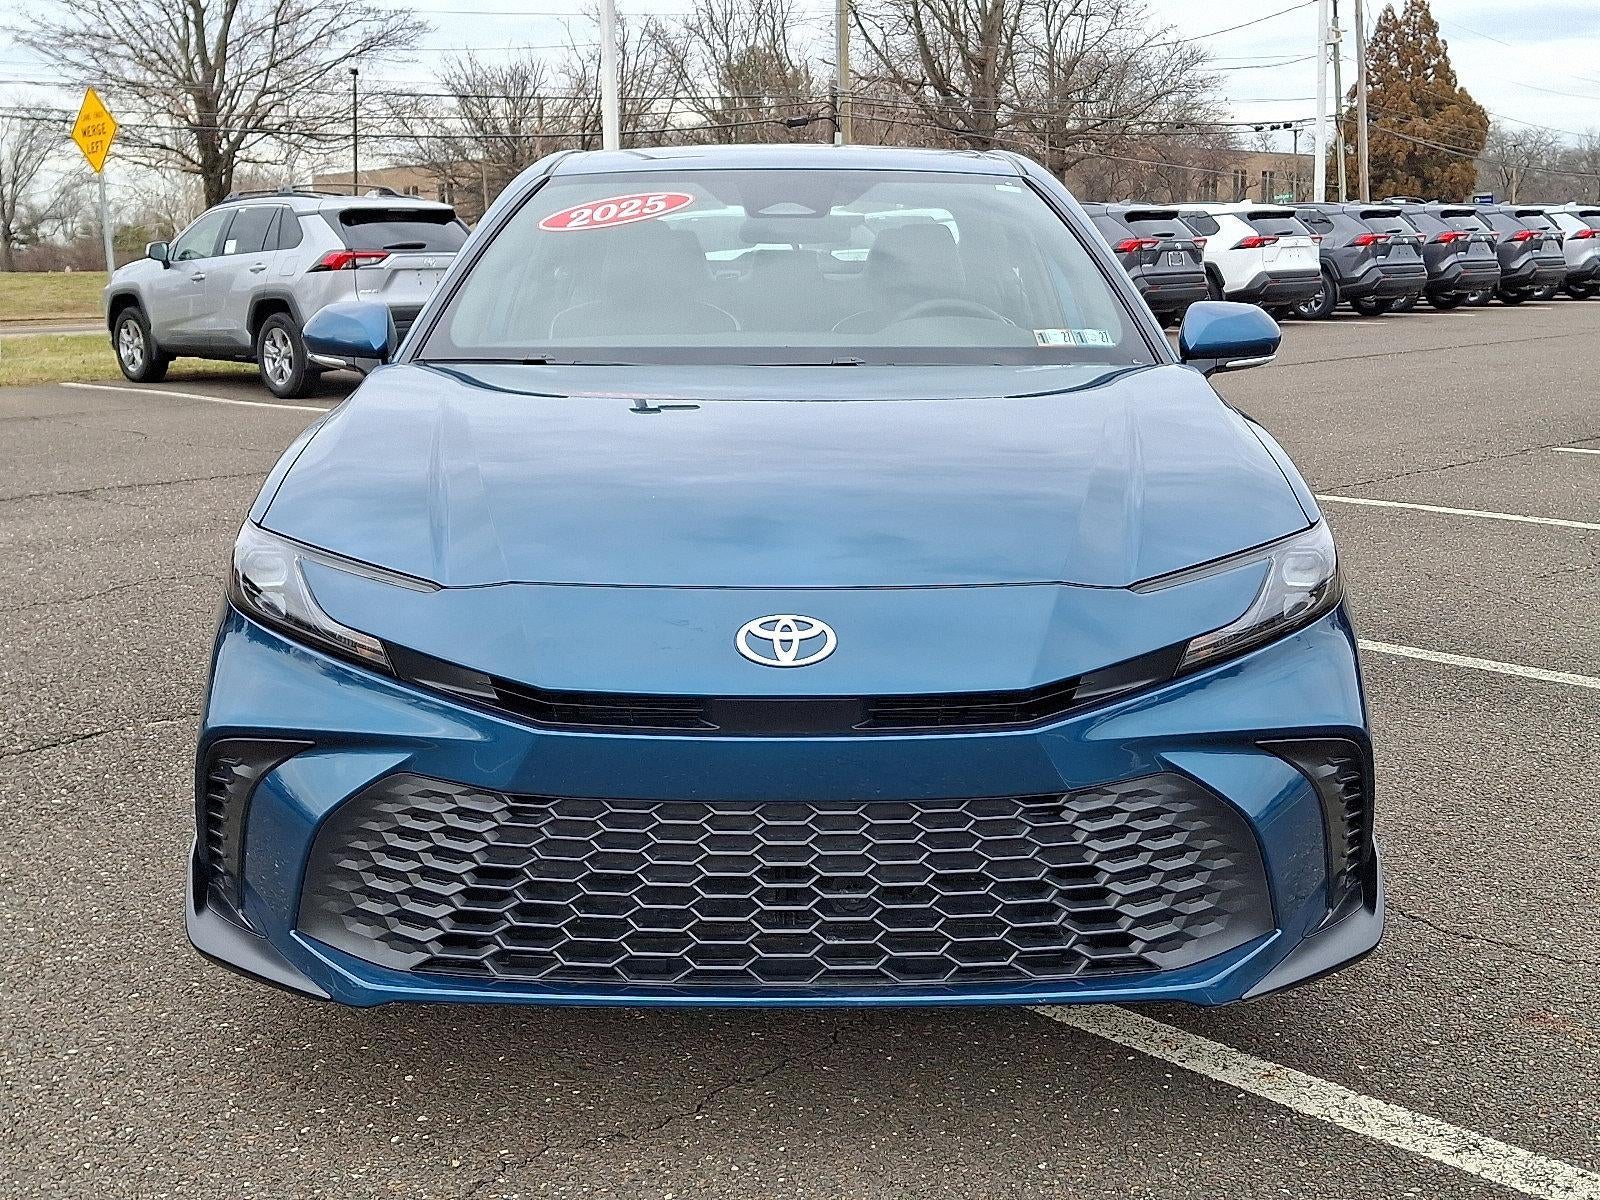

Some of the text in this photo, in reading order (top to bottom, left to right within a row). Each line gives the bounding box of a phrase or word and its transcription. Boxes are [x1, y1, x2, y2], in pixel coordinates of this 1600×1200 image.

[81, 122, 106, 138] MERGE
[86, 140, 104, 154] LEFT
[566, 194, 668, 228] 2025
[1061, 331, 1072, 343] 27
[1099, 331, 1110, 343] 27
